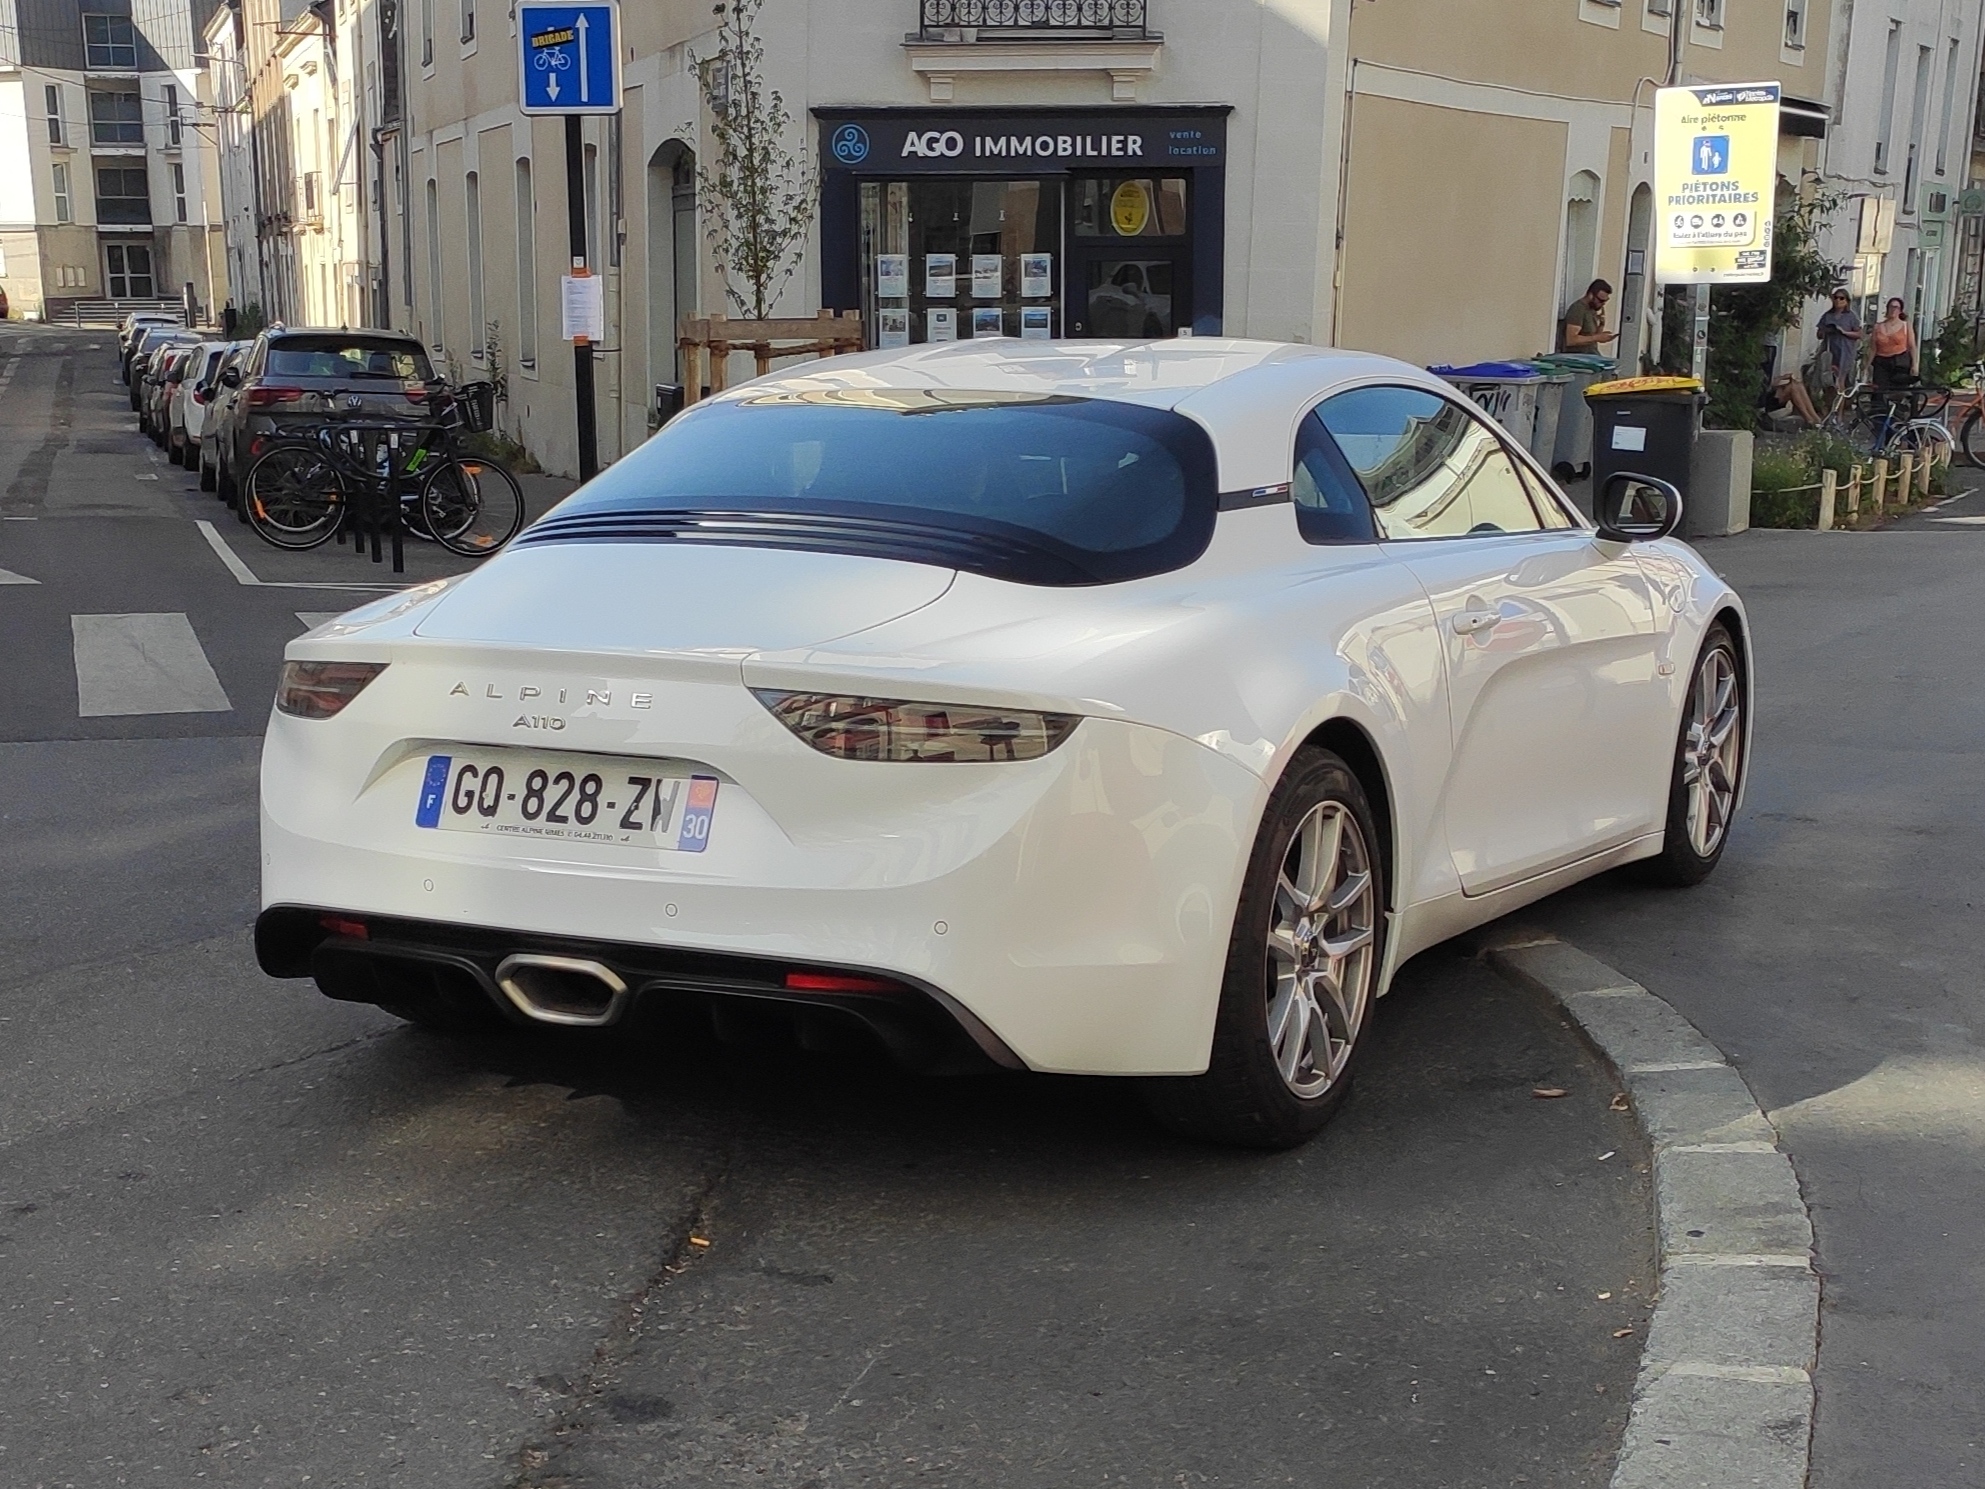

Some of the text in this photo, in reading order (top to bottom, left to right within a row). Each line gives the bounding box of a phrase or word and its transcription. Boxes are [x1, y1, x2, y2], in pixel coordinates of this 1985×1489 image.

[1681, 115, 1699, 124] Aire
[1169, 131, 1202, 139] vente
[901, 131, 1143, 157] AGO IMMOBILIER
[1168, 145, 1217, 155] location
[1668, 192, 1759, 206] PRIORITAIRES
[450, 681, 653, 710] ALPINE
[512, 713, 566, 731] A110
[426, 793, 436, 809] F
[451, 764, 681, 834] GQ-828-ZW
[682, 813, 709, 840] 30
